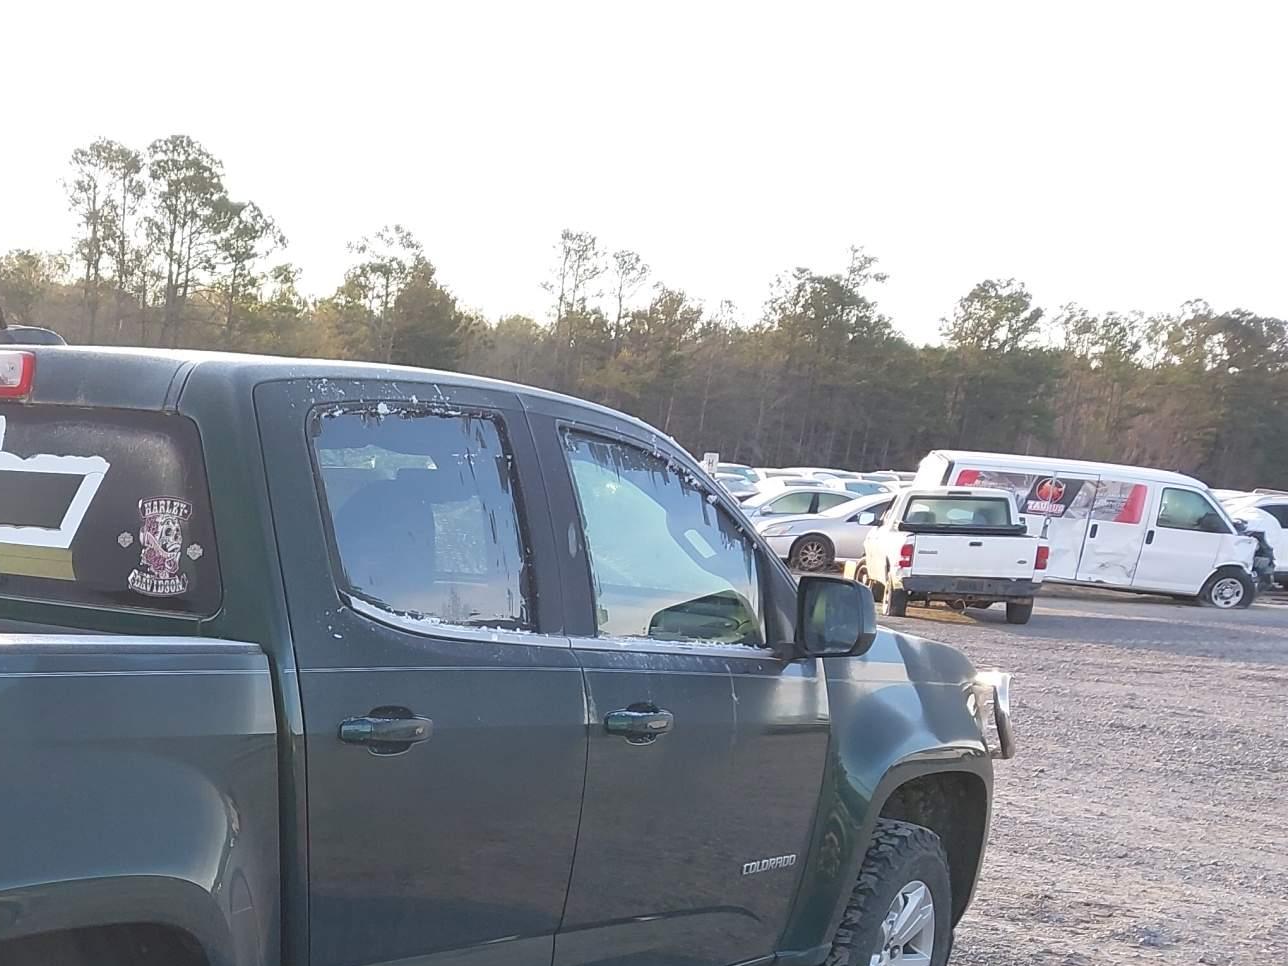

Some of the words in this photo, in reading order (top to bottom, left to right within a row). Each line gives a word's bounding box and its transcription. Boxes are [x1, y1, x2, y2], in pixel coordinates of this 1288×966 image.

[144, 500, 188, 516] HARLEY-
[133, 575, 186, 593] DAVIDSON
[743, 854, 796, 875] COLORADO
